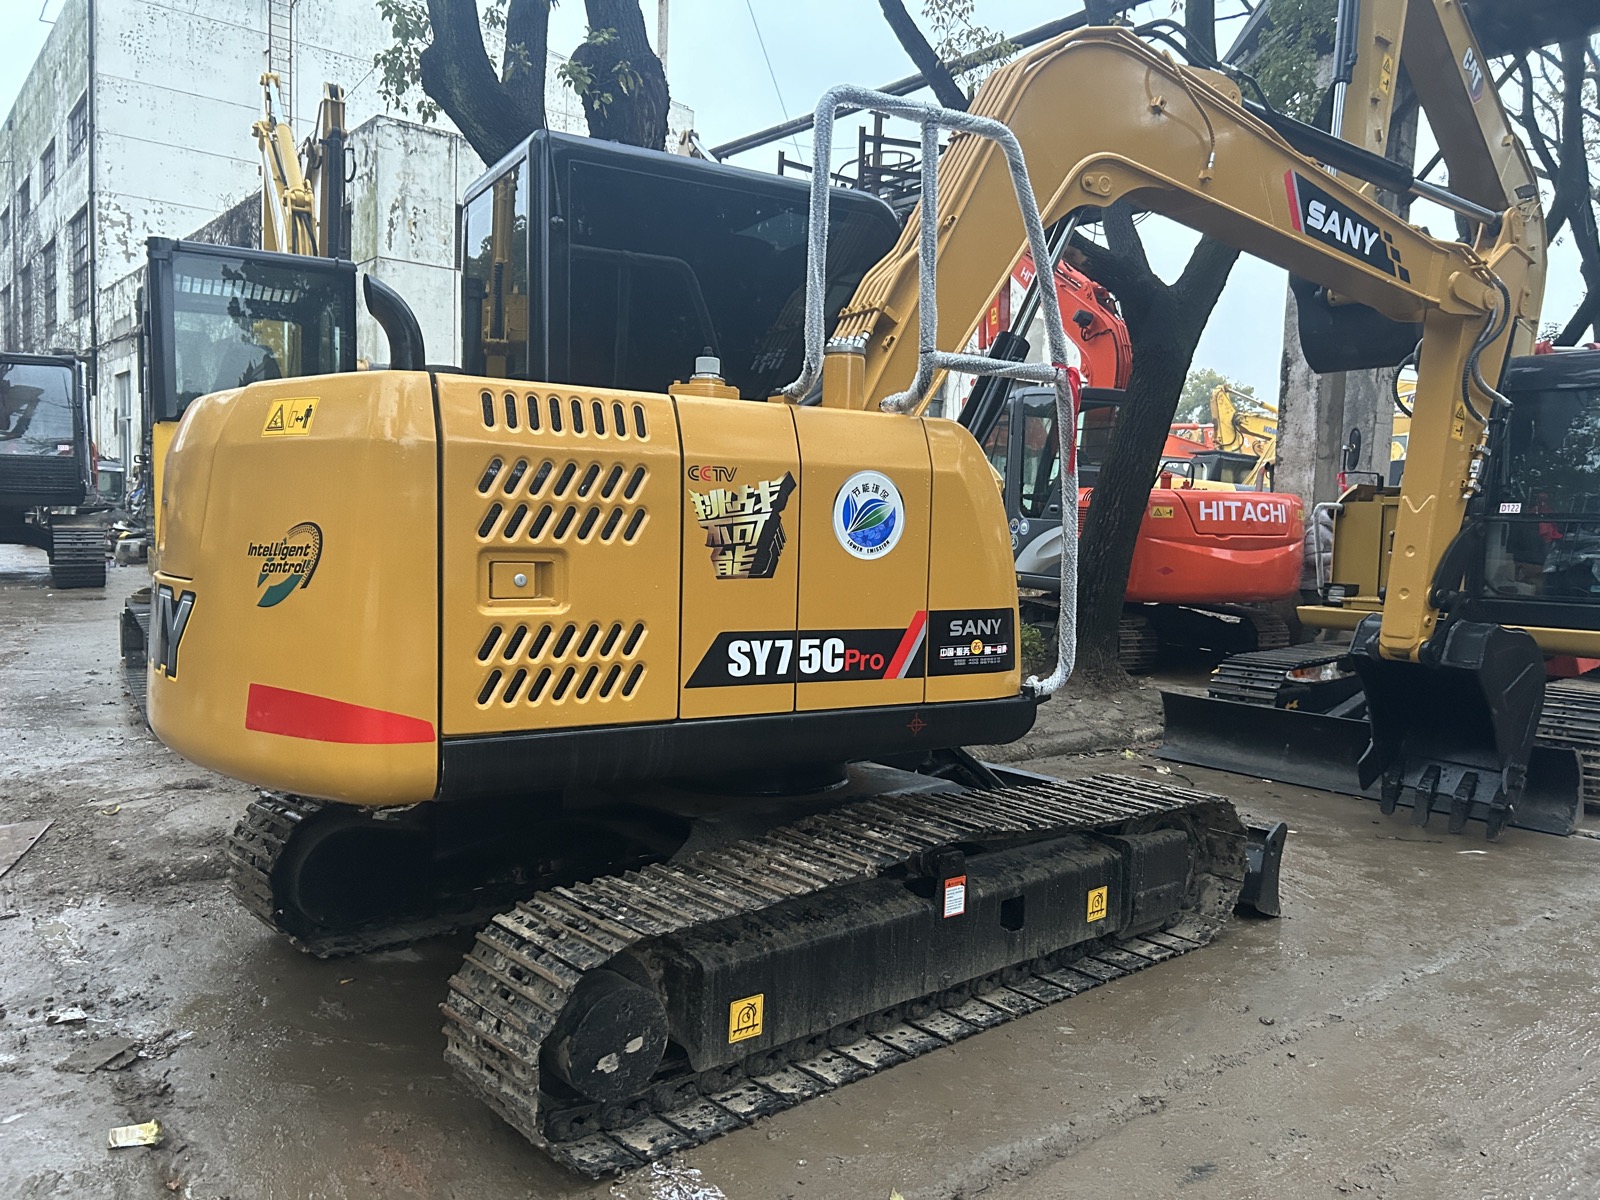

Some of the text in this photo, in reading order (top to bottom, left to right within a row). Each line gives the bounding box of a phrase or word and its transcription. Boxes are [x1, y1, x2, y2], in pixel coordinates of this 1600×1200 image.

[1463, 46, 1482, 90] CAT
[1306, 199, 1379, 255] SANY
[688, 465, 737, 482] CCTV
[688, 478, 783, 520] 挑战
[1501, 504, 1520, 513] D122
[1199, 500, 1287, 524] HITACHI
[698, 512, 772, 547] 不可
[247, 541, 311, 560] Intelligent
[847, 539, 890, 553] LOWER EMISSION
[262, 560, 307, 573] control
[710, 545, 758, 578] 能
[949, 618, 1002, 636] SANY
